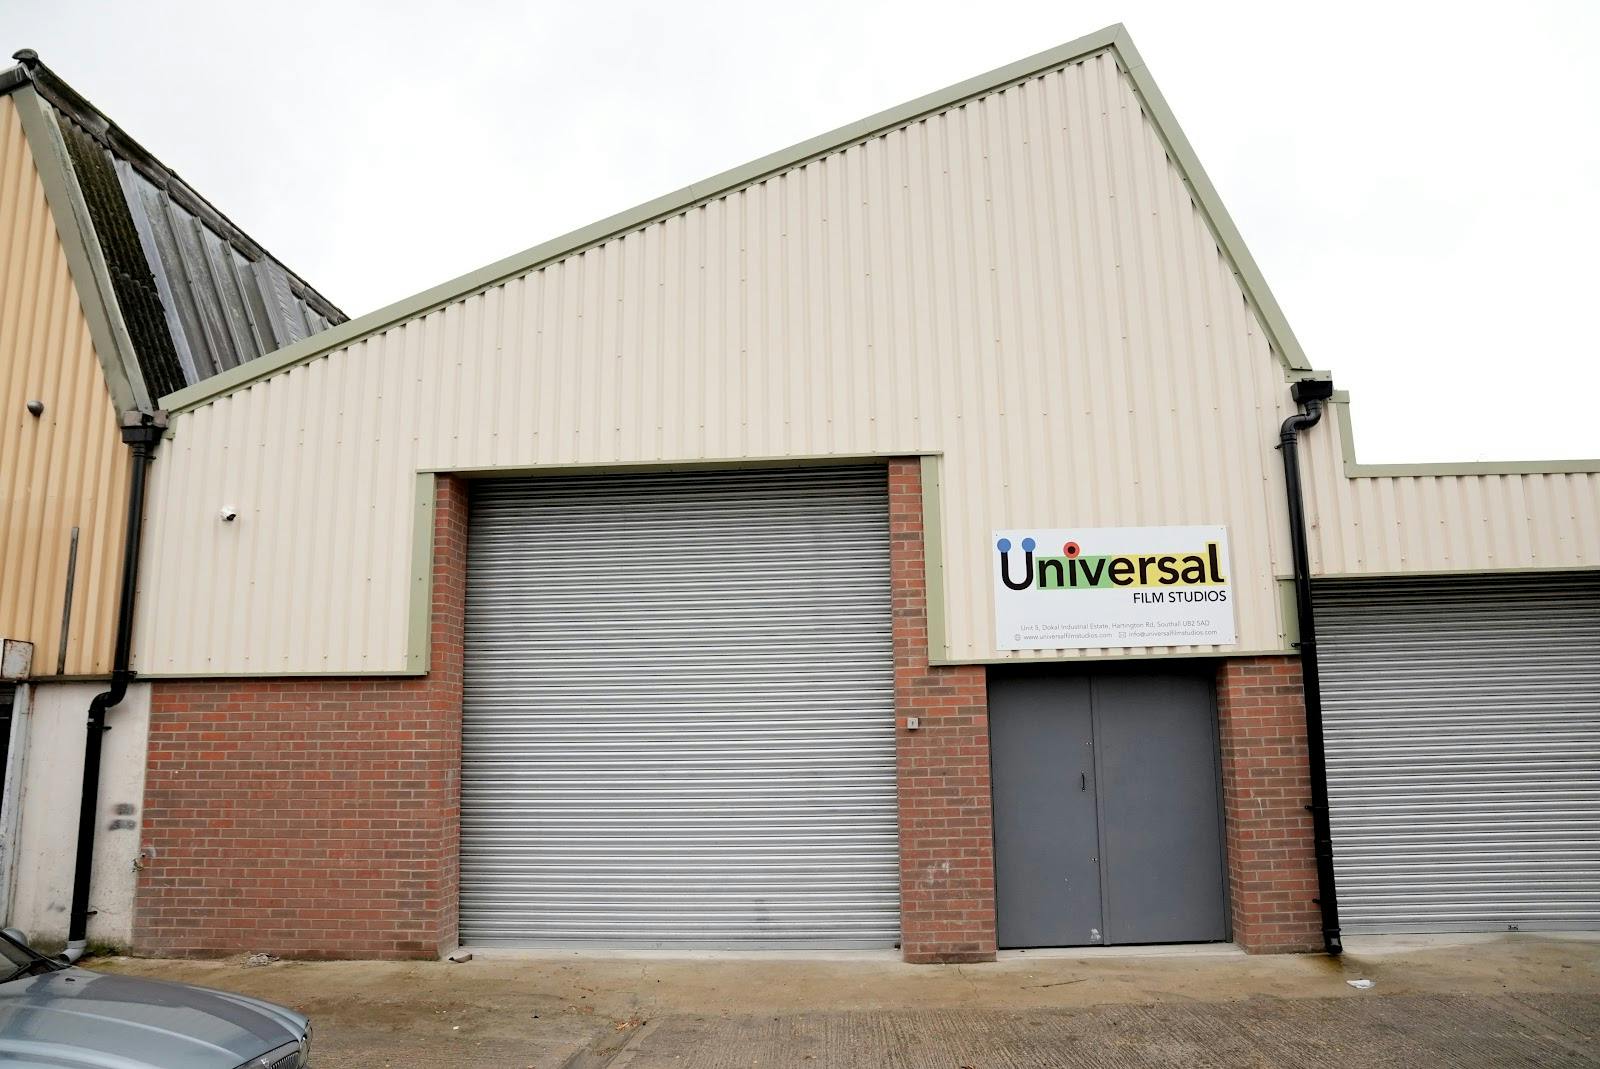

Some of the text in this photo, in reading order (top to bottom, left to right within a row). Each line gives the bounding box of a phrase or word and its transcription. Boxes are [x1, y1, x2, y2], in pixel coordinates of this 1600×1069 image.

[997, 538, 1225, 590] Universal
[1133, 590, 1227, 603] FILM STUDIOS
[1061, 622, 1089, 630] Industrial
[1090, 622, 1110, 630] Estate,
[1112, 621, 1144, 631] Hartington
[1157, 620, 1181, 628] Southall
[1182, 619, 1195, 627] UB2
[1023, 630, 1218, 640] www.universalfilmstudios.com info@universalfilmstudios.com
